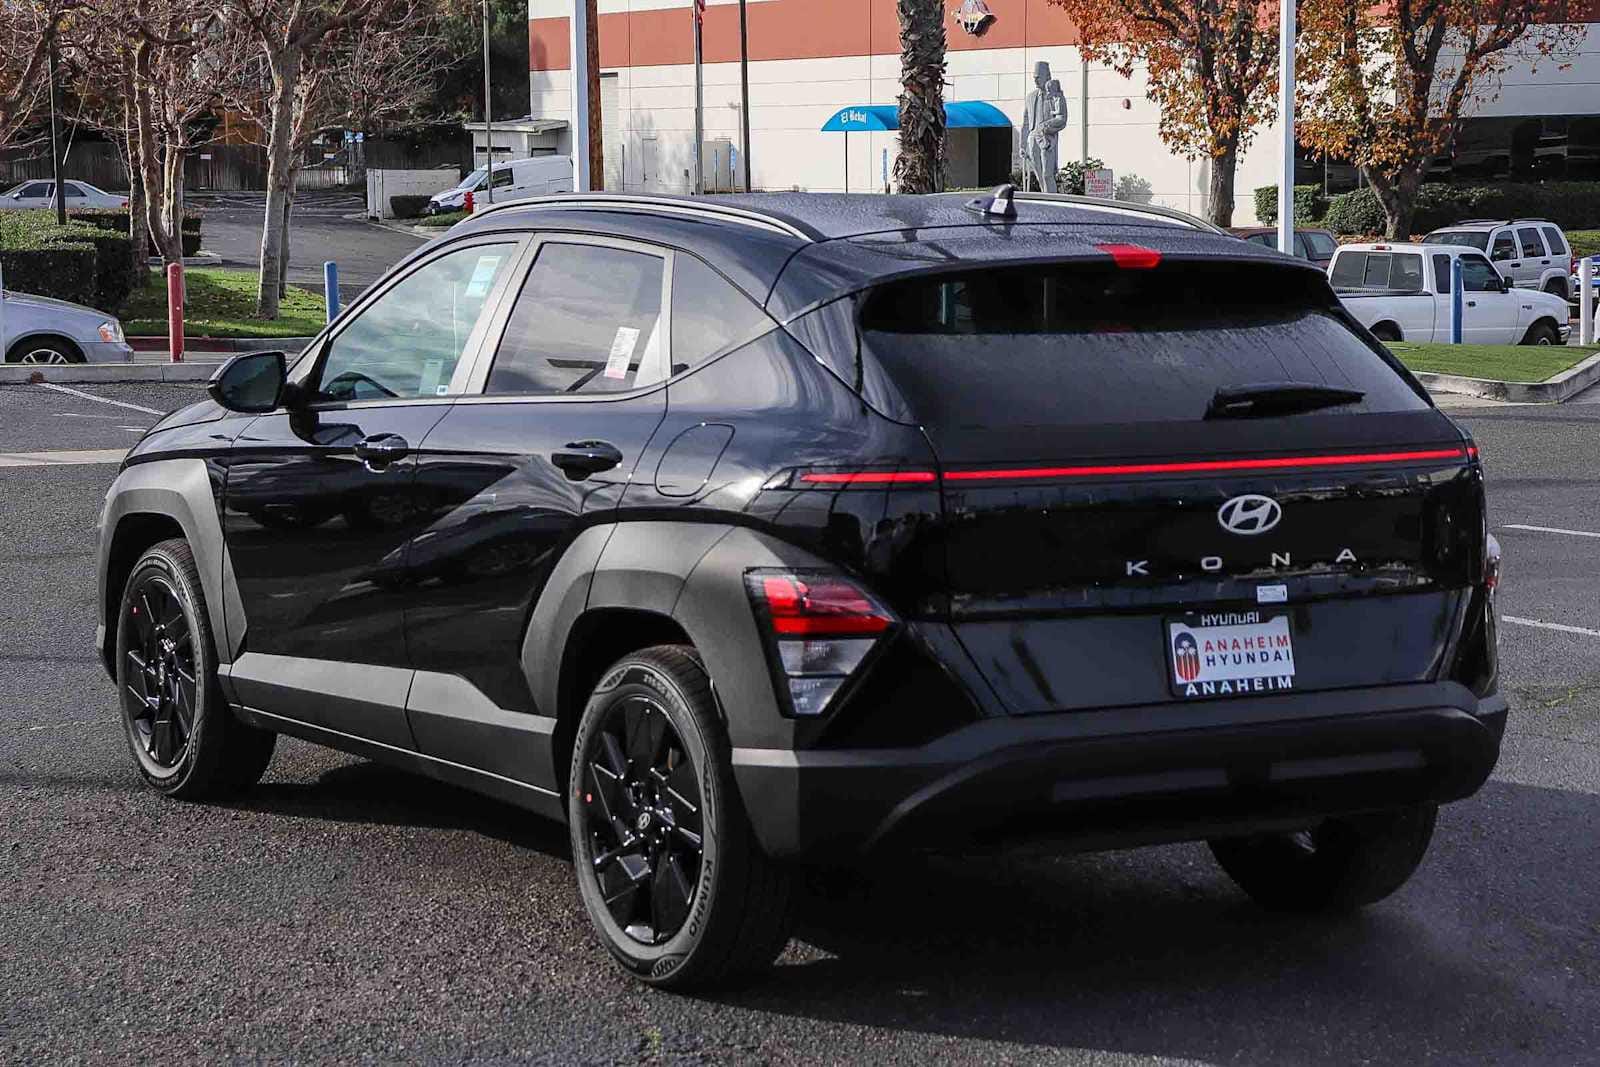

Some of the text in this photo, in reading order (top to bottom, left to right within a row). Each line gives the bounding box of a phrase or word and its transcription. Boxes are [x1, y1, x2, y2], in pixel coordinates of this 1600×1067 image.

[1126, 549, 1356, 576] KONA
[1201, 611, 1259, 626] HYUNDAI
[1204, 635, 1289, 652] ANAHEIM
[1206, 649, 1290, 666] HYUNDAI
[1186, 676, 1293, 697] ANAHEIM
[689, 859, 713, 937] KUMHO
